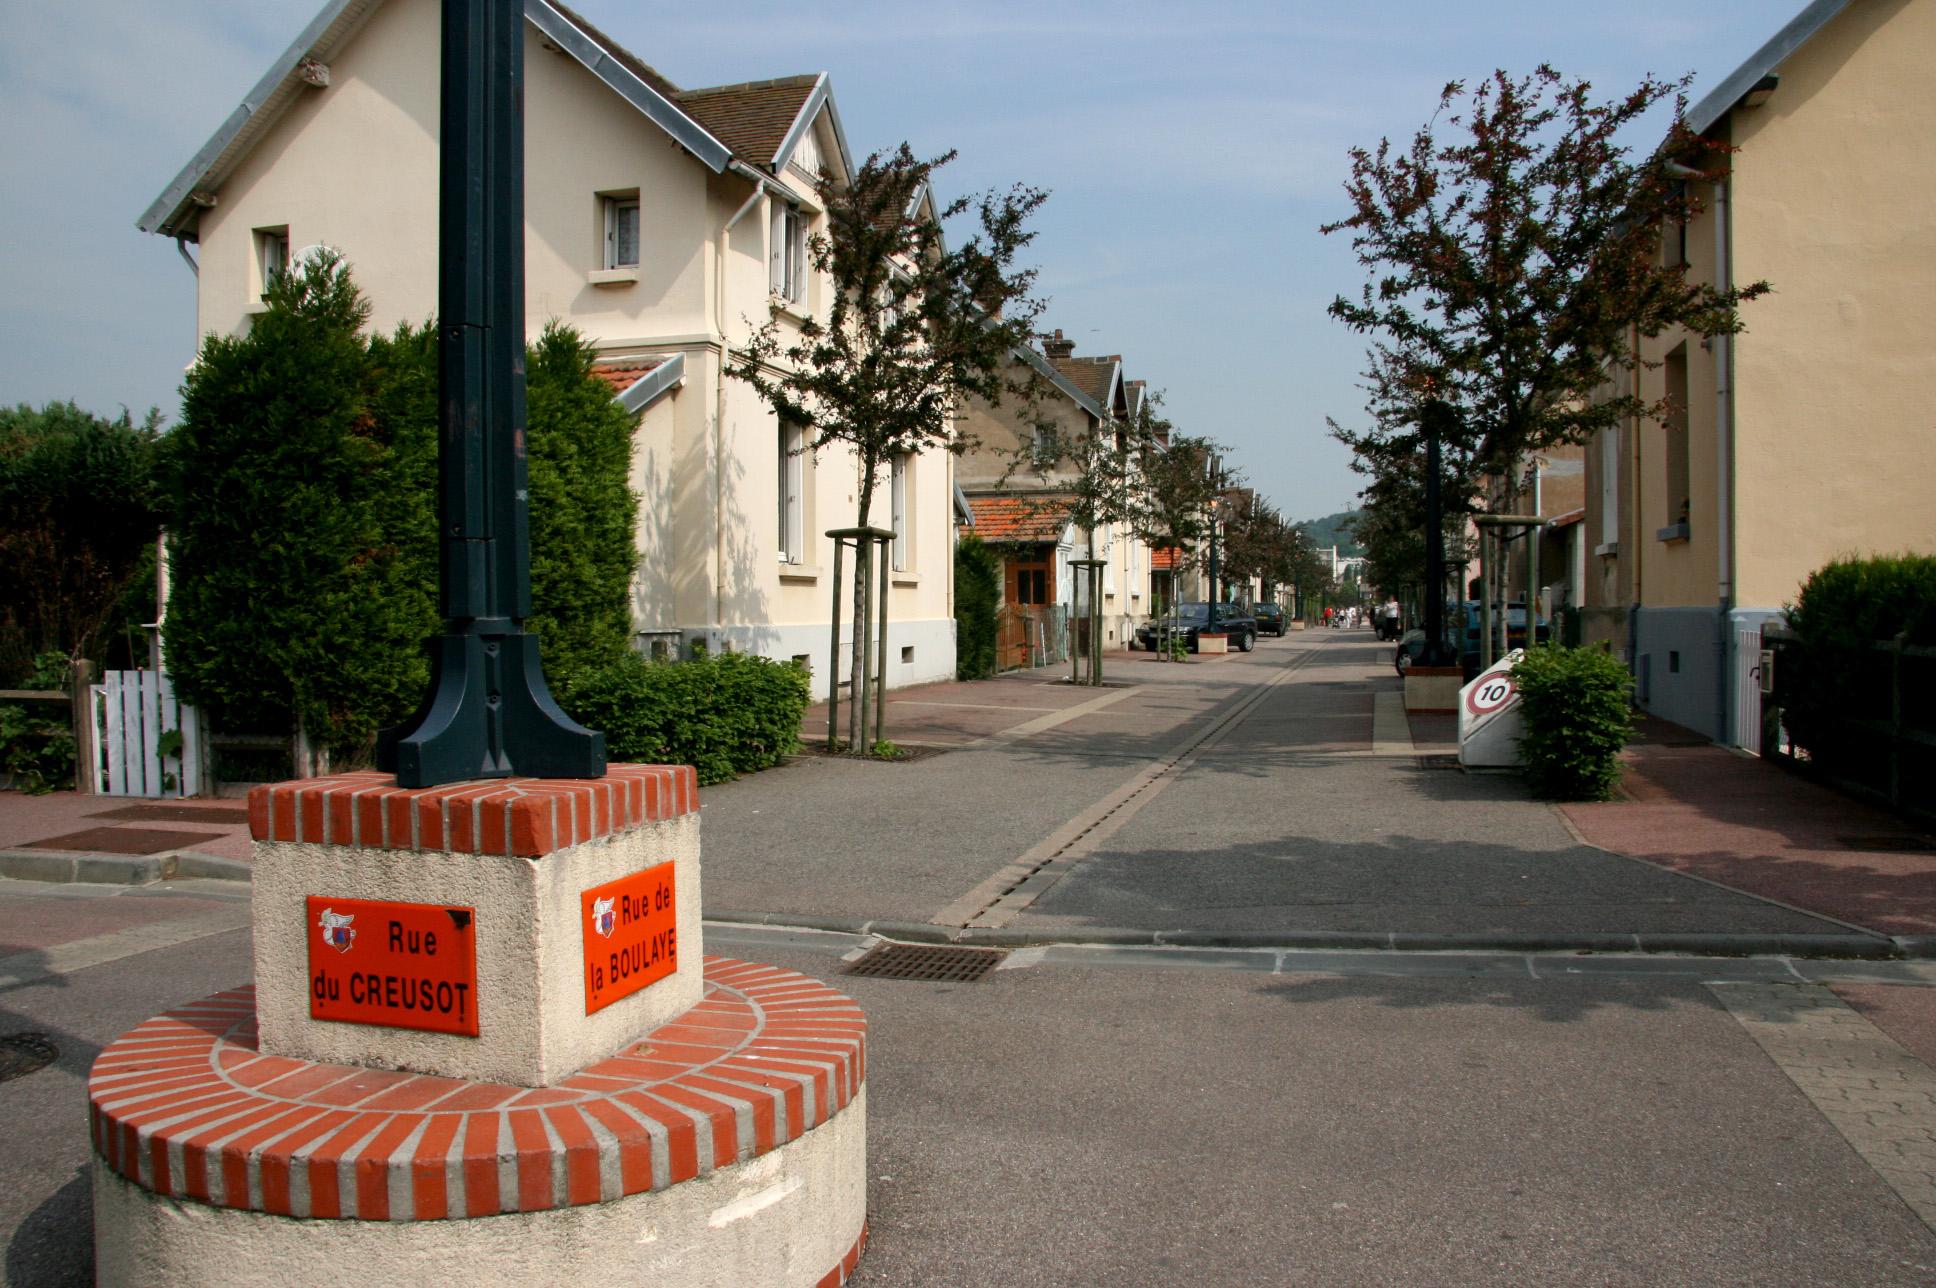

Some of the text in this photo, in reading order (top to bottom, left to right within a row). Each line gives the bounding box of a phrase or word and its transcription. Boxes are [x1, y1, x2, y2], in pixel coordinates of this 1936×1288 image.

[1481, 685, 1506, 701] 10
[622, 882, 670, 925] Rue de
[388, 920, 437, 955] Rue
[591, 928, 675, 992] la BOULAYE
[314, 969, 469, 1017] du CREUSOT
